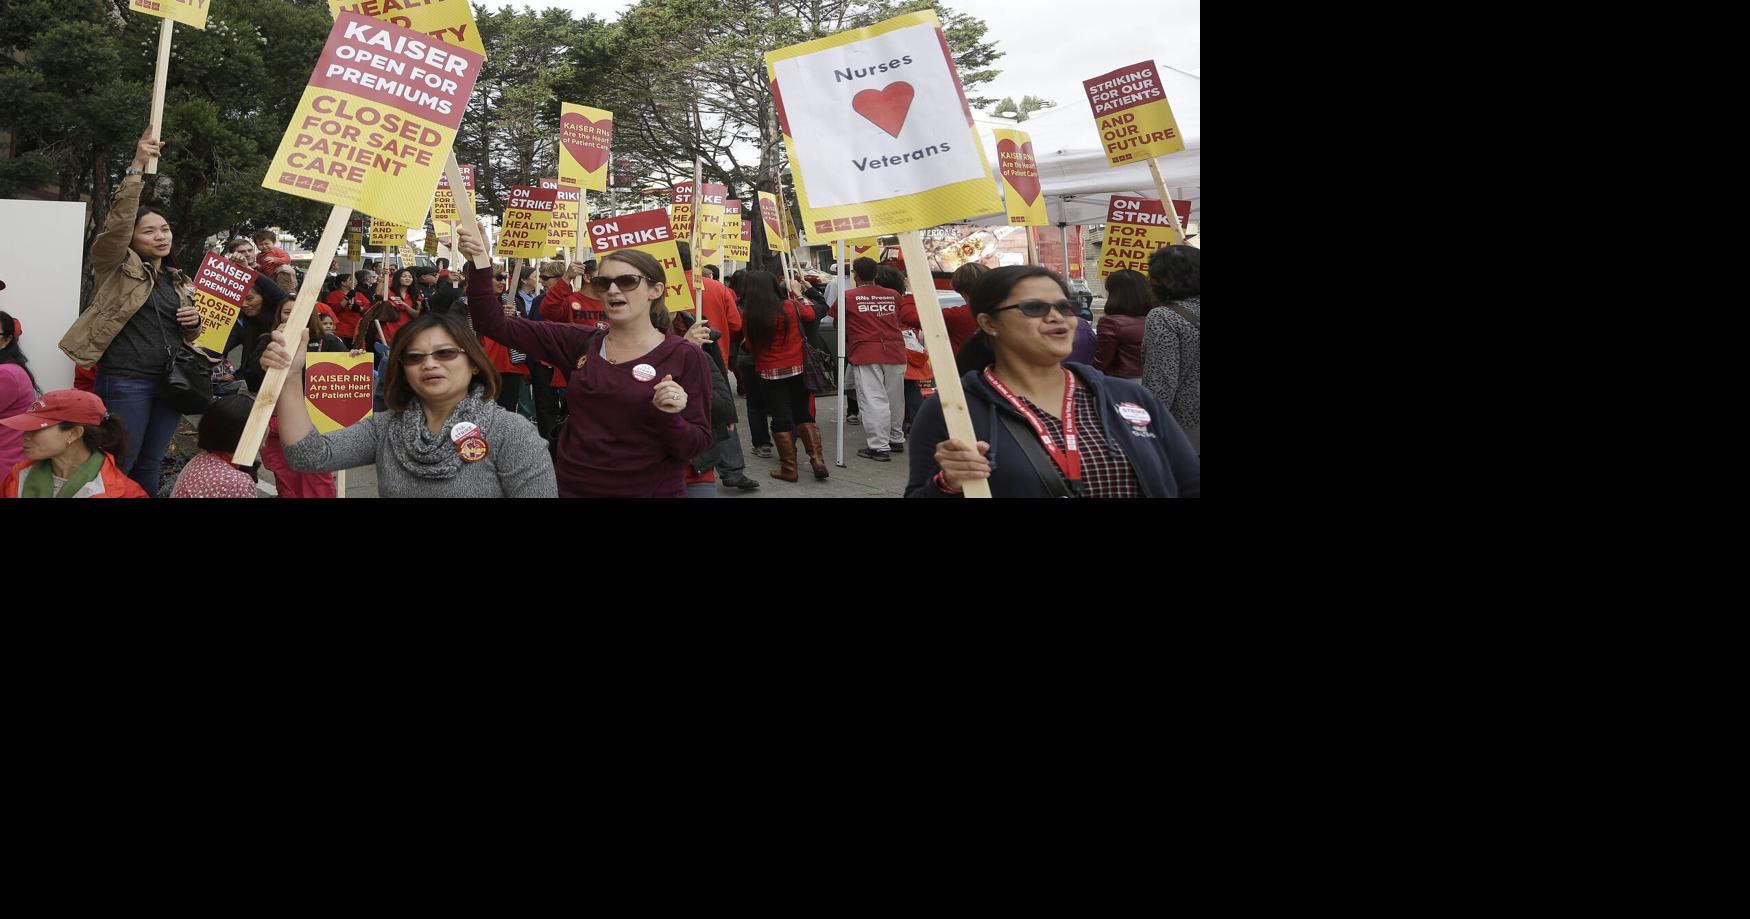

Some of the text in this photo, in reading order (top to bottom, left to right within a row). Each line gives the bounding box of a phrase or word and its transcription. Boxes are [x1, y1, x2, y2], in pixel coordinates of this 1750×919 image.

[343, 21, 469, 78] KAISER
[335, 45, 458, 96] OPEN FOR
[833, 54, 913, 83] Nurses
[325, 64, 453, 115] PREMIUMS
[1089, 68, 1152, 95] STRIKING
[1092, 79, 1154, 104] FOR OUR
[1095, 87, 1161, 114] PATIENTS
[311, 95, 442, 147] CLOSED
[1101, 112, 1135, 130] AND
[563, 122, 610, 137] KAISER RNs
[563, 130, 577, 138] Are
[592, 136, 609, 144] Heart
[1103, 124, 1139, 141] OUR
[301, 115, 433, 167] FOR SAFE
[571, 138, 595, 148] Patient
[1107, 127, 1176, 154] FUTURE
[293, 133, 408, 176] PATIENT
[851, 141, 951, 172] Veterans
[1000, 151, 1023, 160] KAISER
[286, 152, 367, 183] CARE
[513, 189, 530, 198] ON
[542, 181, 558, 190] ON
[510, 198, 553, 210] STRIKE
[1113, 199, 1140, 211] ON
[508, 210, 532, 220] FOR
[552, 211, 578, 220] EALT
[505, 220, 548, 231] HEALTH
[592, 221, 620, 236] ON
[1110, 225, 1147, 238] FOR
[503, 229, 529, 239] AND
[596, 226, 669, 250] STRIKE
[501, 239, 543, 249] SAFETY
[1107, 236, 1171, 250] HEALT
[1105, 247, 1145, 260] AND
[207, 256, 252, 284] KAISER
[1103, 258, 1149, 272] SAFE
[203, 268, 245, 293] OPEN FOR
[198, 277, 242, 302] PREMIUMS
[208, 309, 232, 326] SAFE
[310, 374, 371, 383] KAISER RNs
[330, 383, 346, 391] the
